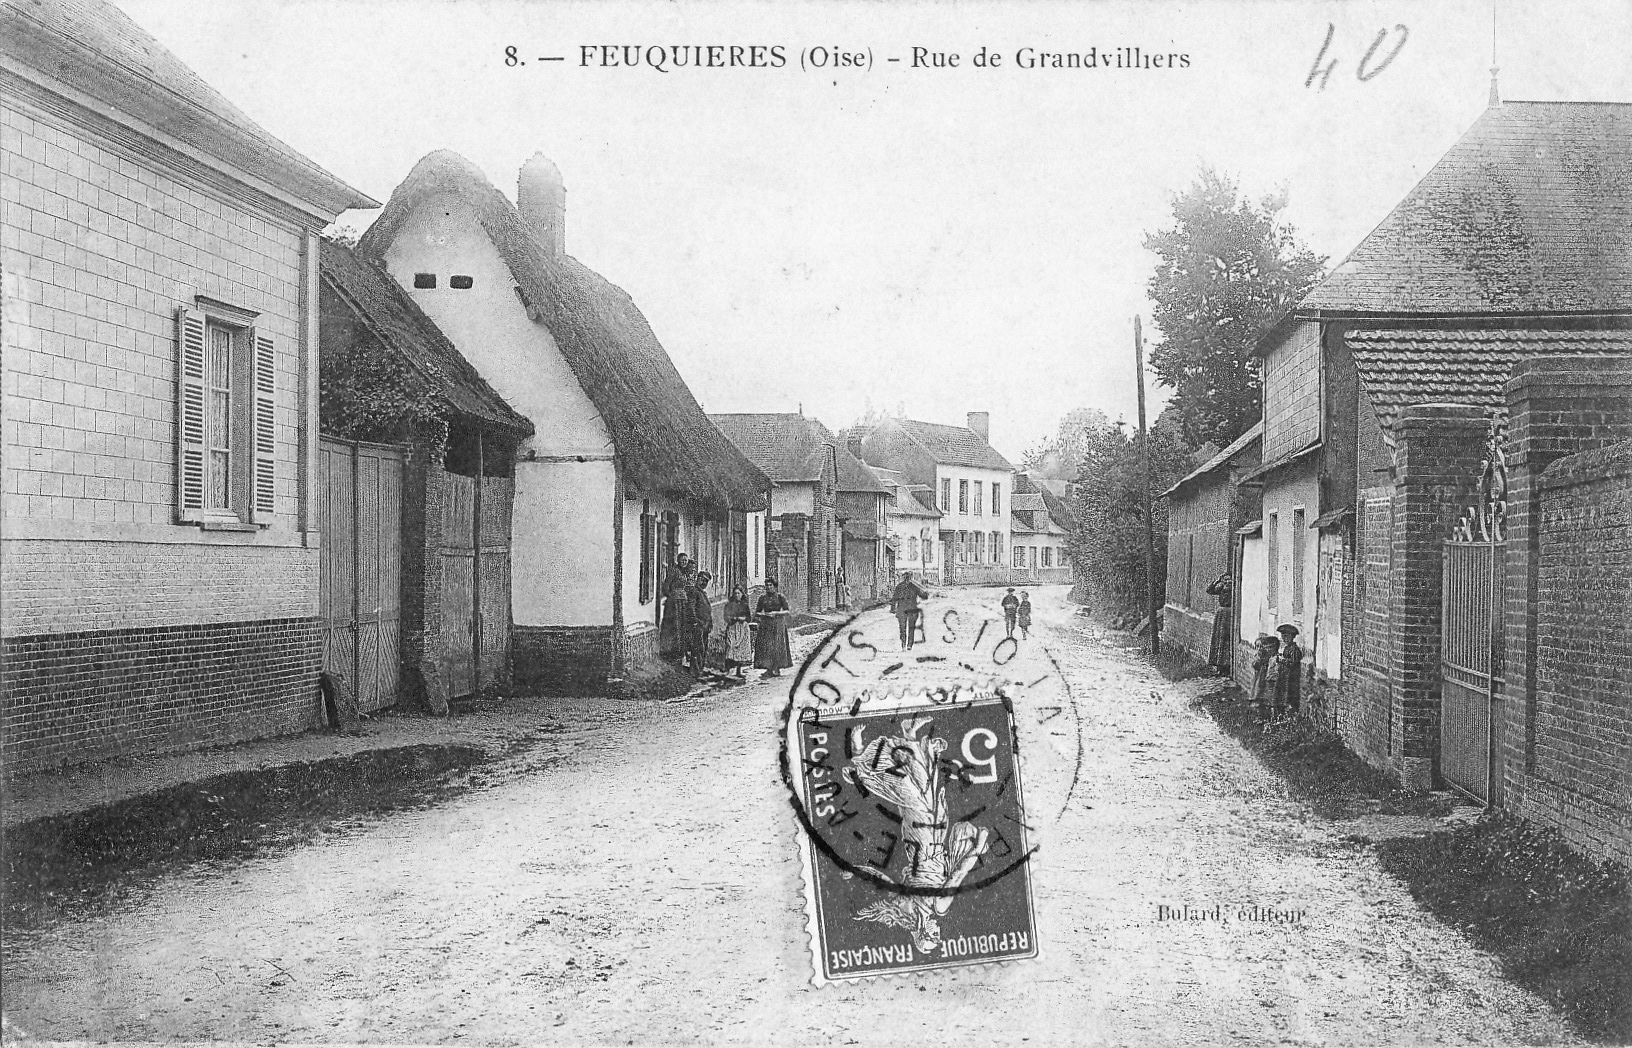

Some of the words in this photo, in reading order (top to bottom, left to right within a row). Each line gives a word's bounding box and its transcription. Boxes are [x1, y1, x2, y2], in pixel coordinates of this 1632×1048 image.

[1304, 22, 1409, 91] 40
[831, 944, 914, 969] FRANÇAISE
[941, 931, 1029, 958] REPUBLIQUE
